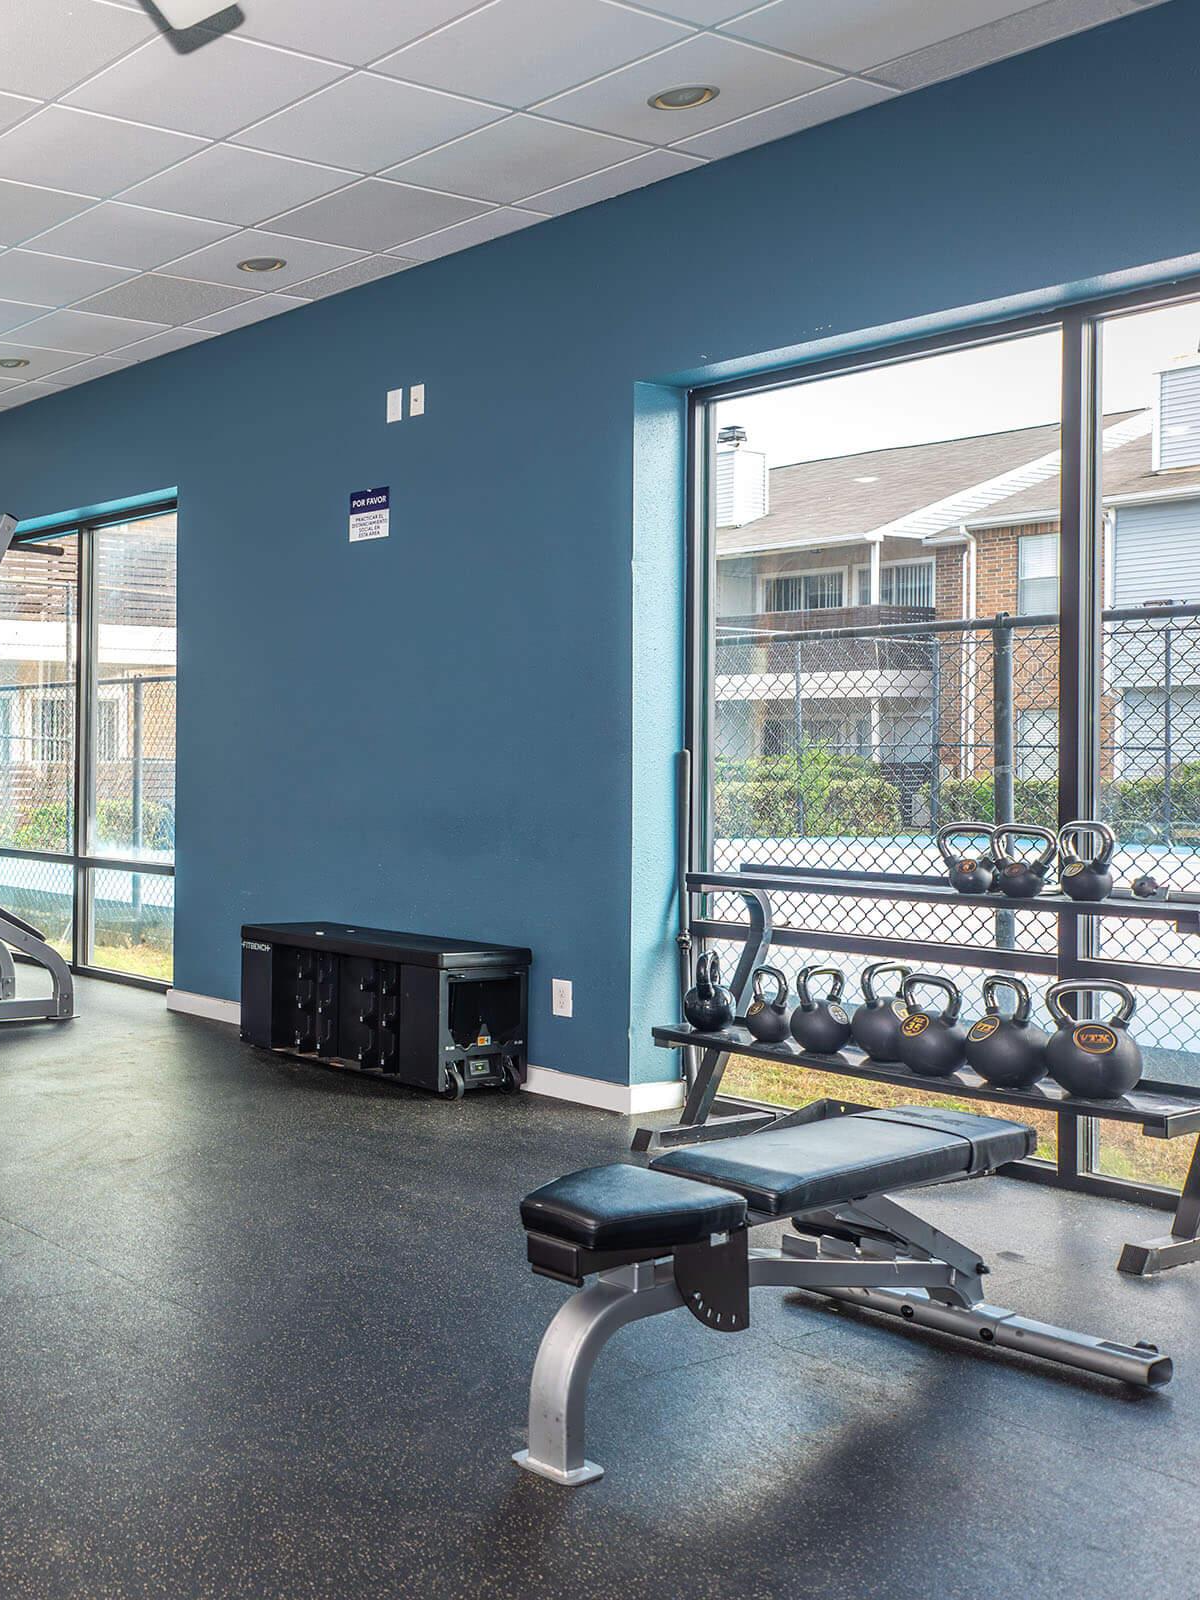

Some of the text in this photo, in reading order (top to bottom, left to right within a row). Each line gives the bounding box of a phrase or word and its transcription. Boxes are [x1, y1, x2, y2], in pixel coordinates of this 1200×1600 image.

[352, 495, 387, 508] POR FAVOR
[905, 1021, 922, 1032] 35
